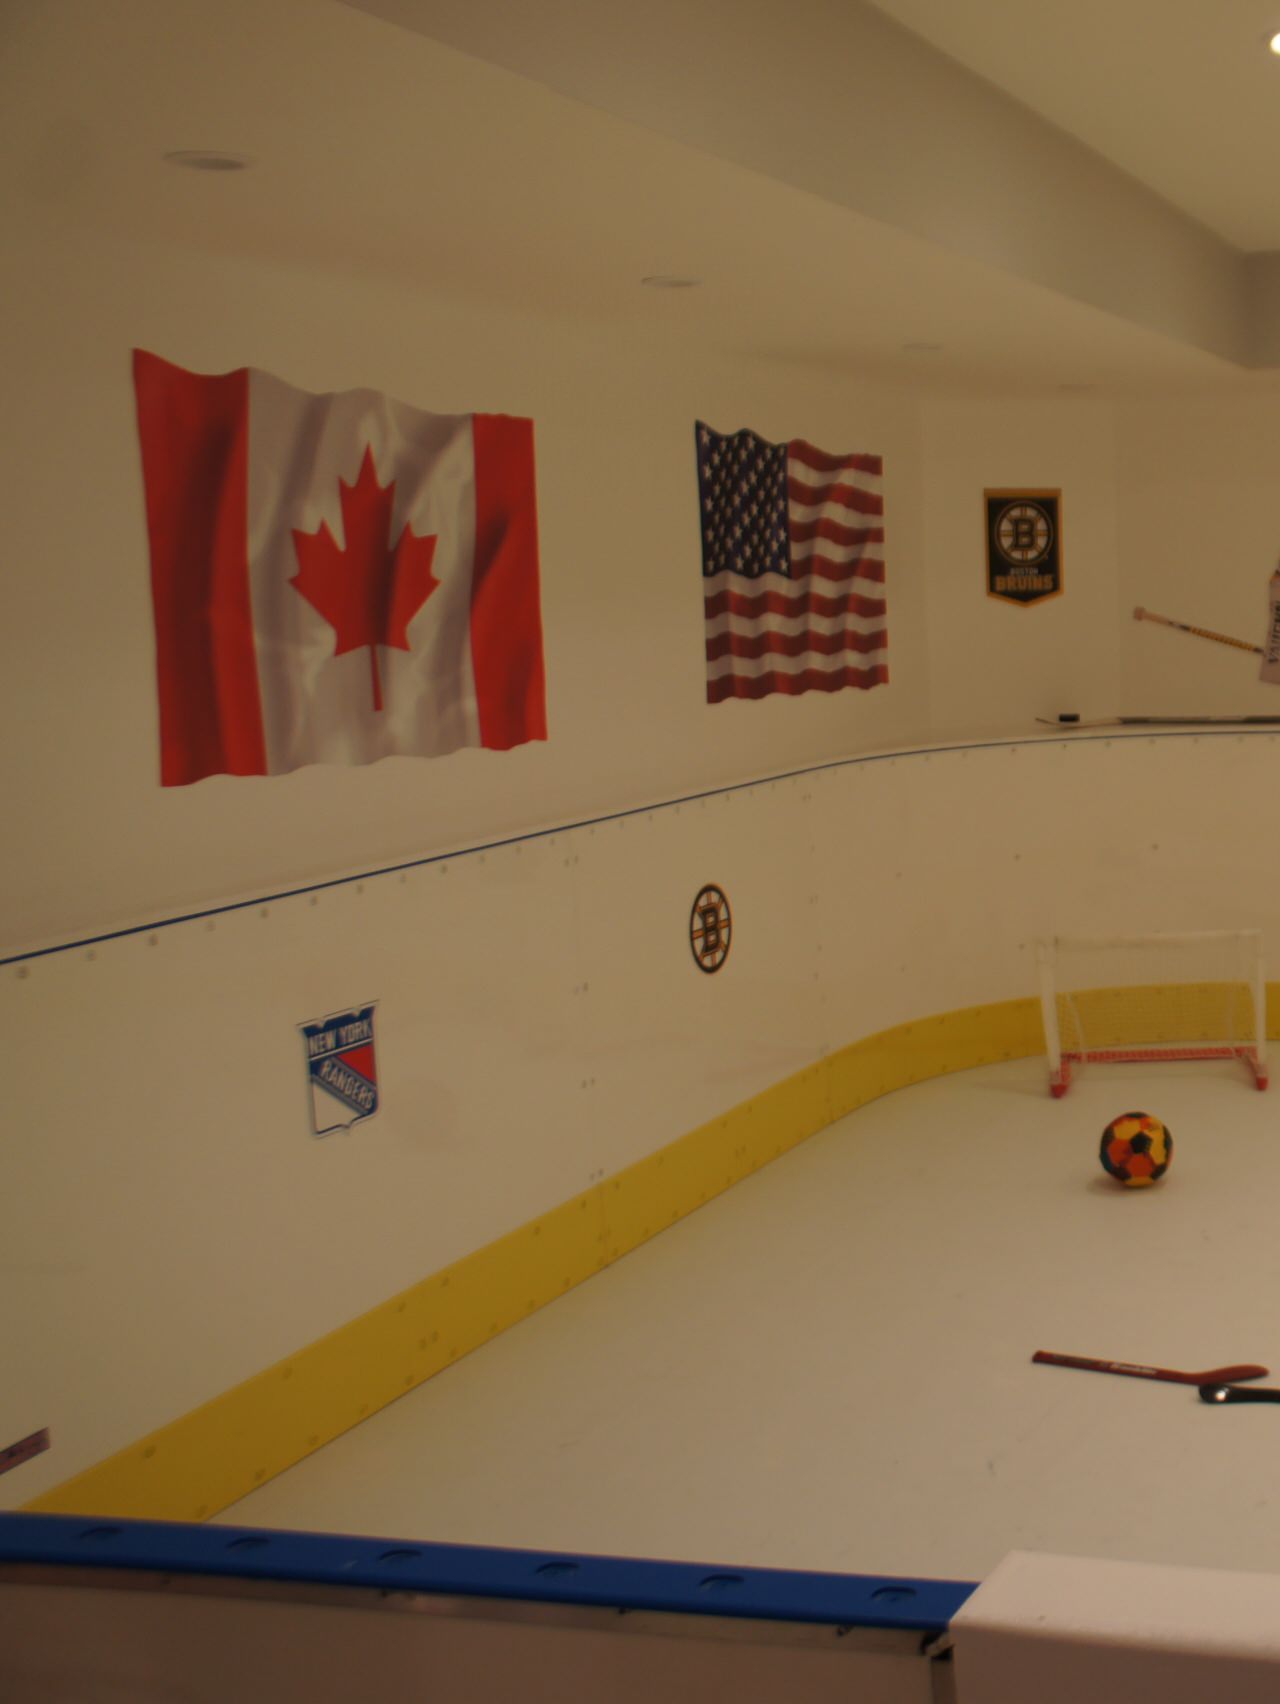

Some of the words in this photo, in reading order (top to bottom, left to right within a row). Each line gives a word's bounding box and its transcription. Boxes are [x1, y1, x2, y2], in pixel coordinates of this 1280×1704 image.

[995, 575, 1054, 591] BRUINS
[309, 1028, 337, 1056] NEW
[338, 1018, 373, 1045] YORK
[320, 1059, 375, 1109] RANGERS
